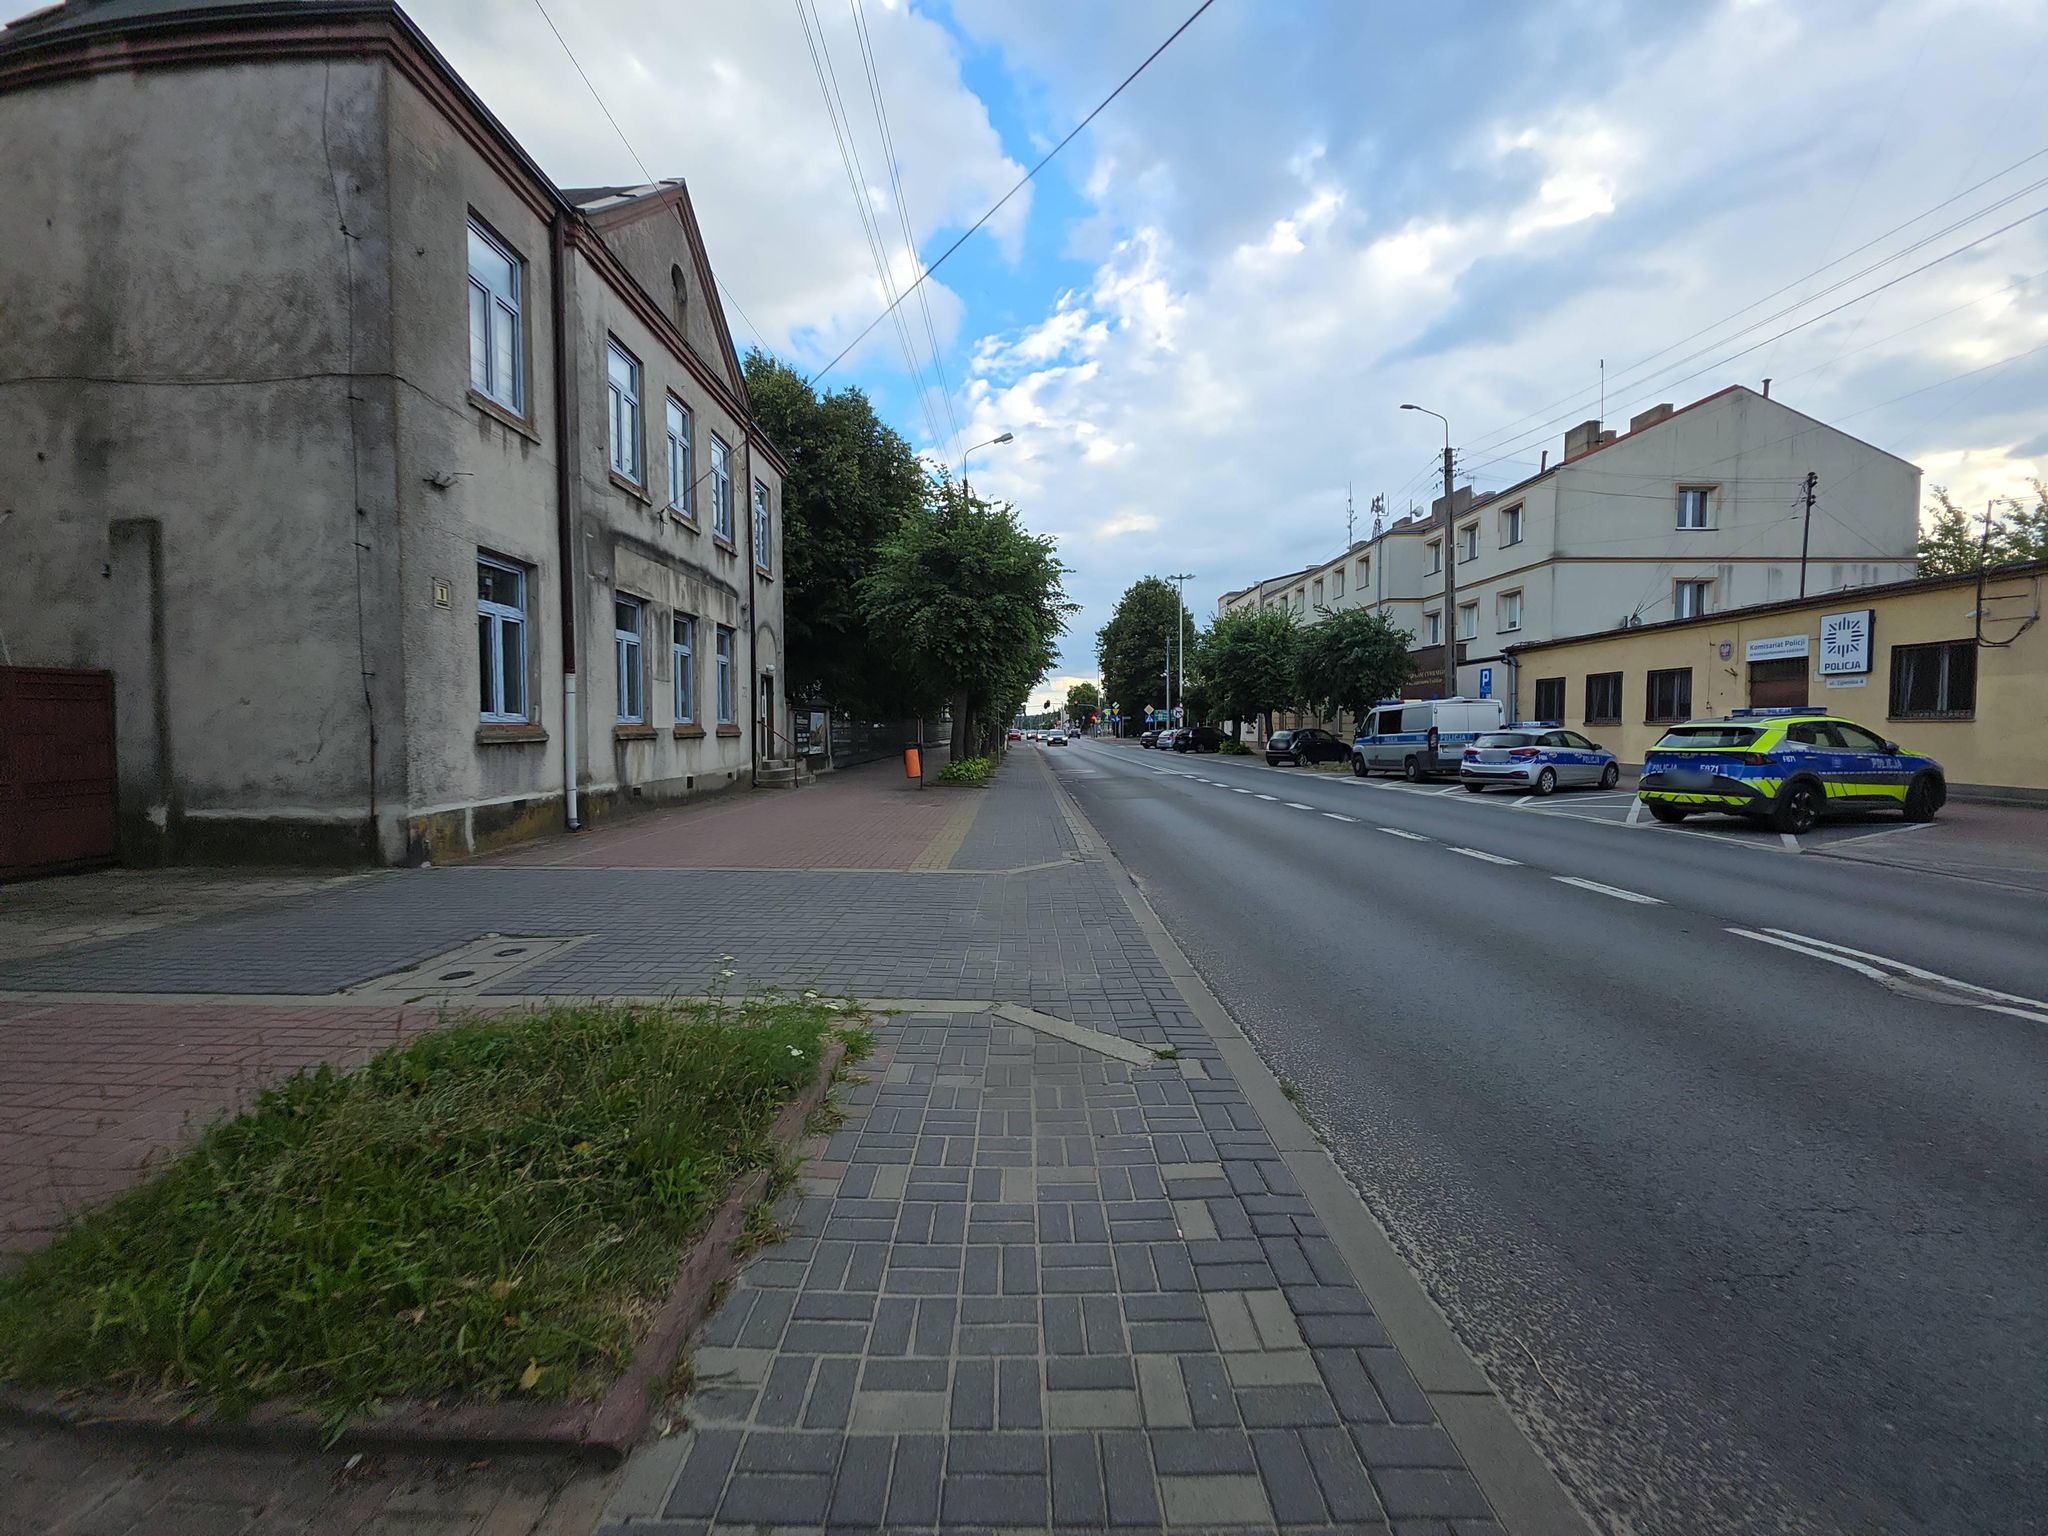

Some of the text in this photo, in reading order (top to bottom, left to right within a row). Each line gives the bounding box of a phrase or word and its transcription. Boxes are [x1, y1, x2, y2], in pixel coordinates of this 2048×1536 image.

[1749, 642, 1783, 651] Komisariat
[1824, 661, 1861, 671] POLICJA
[1482, 670, 1490, 686] P
[1650, 763, 1678, 771] POLICJA
[1870, 758, 1903, 769] POLICJA
